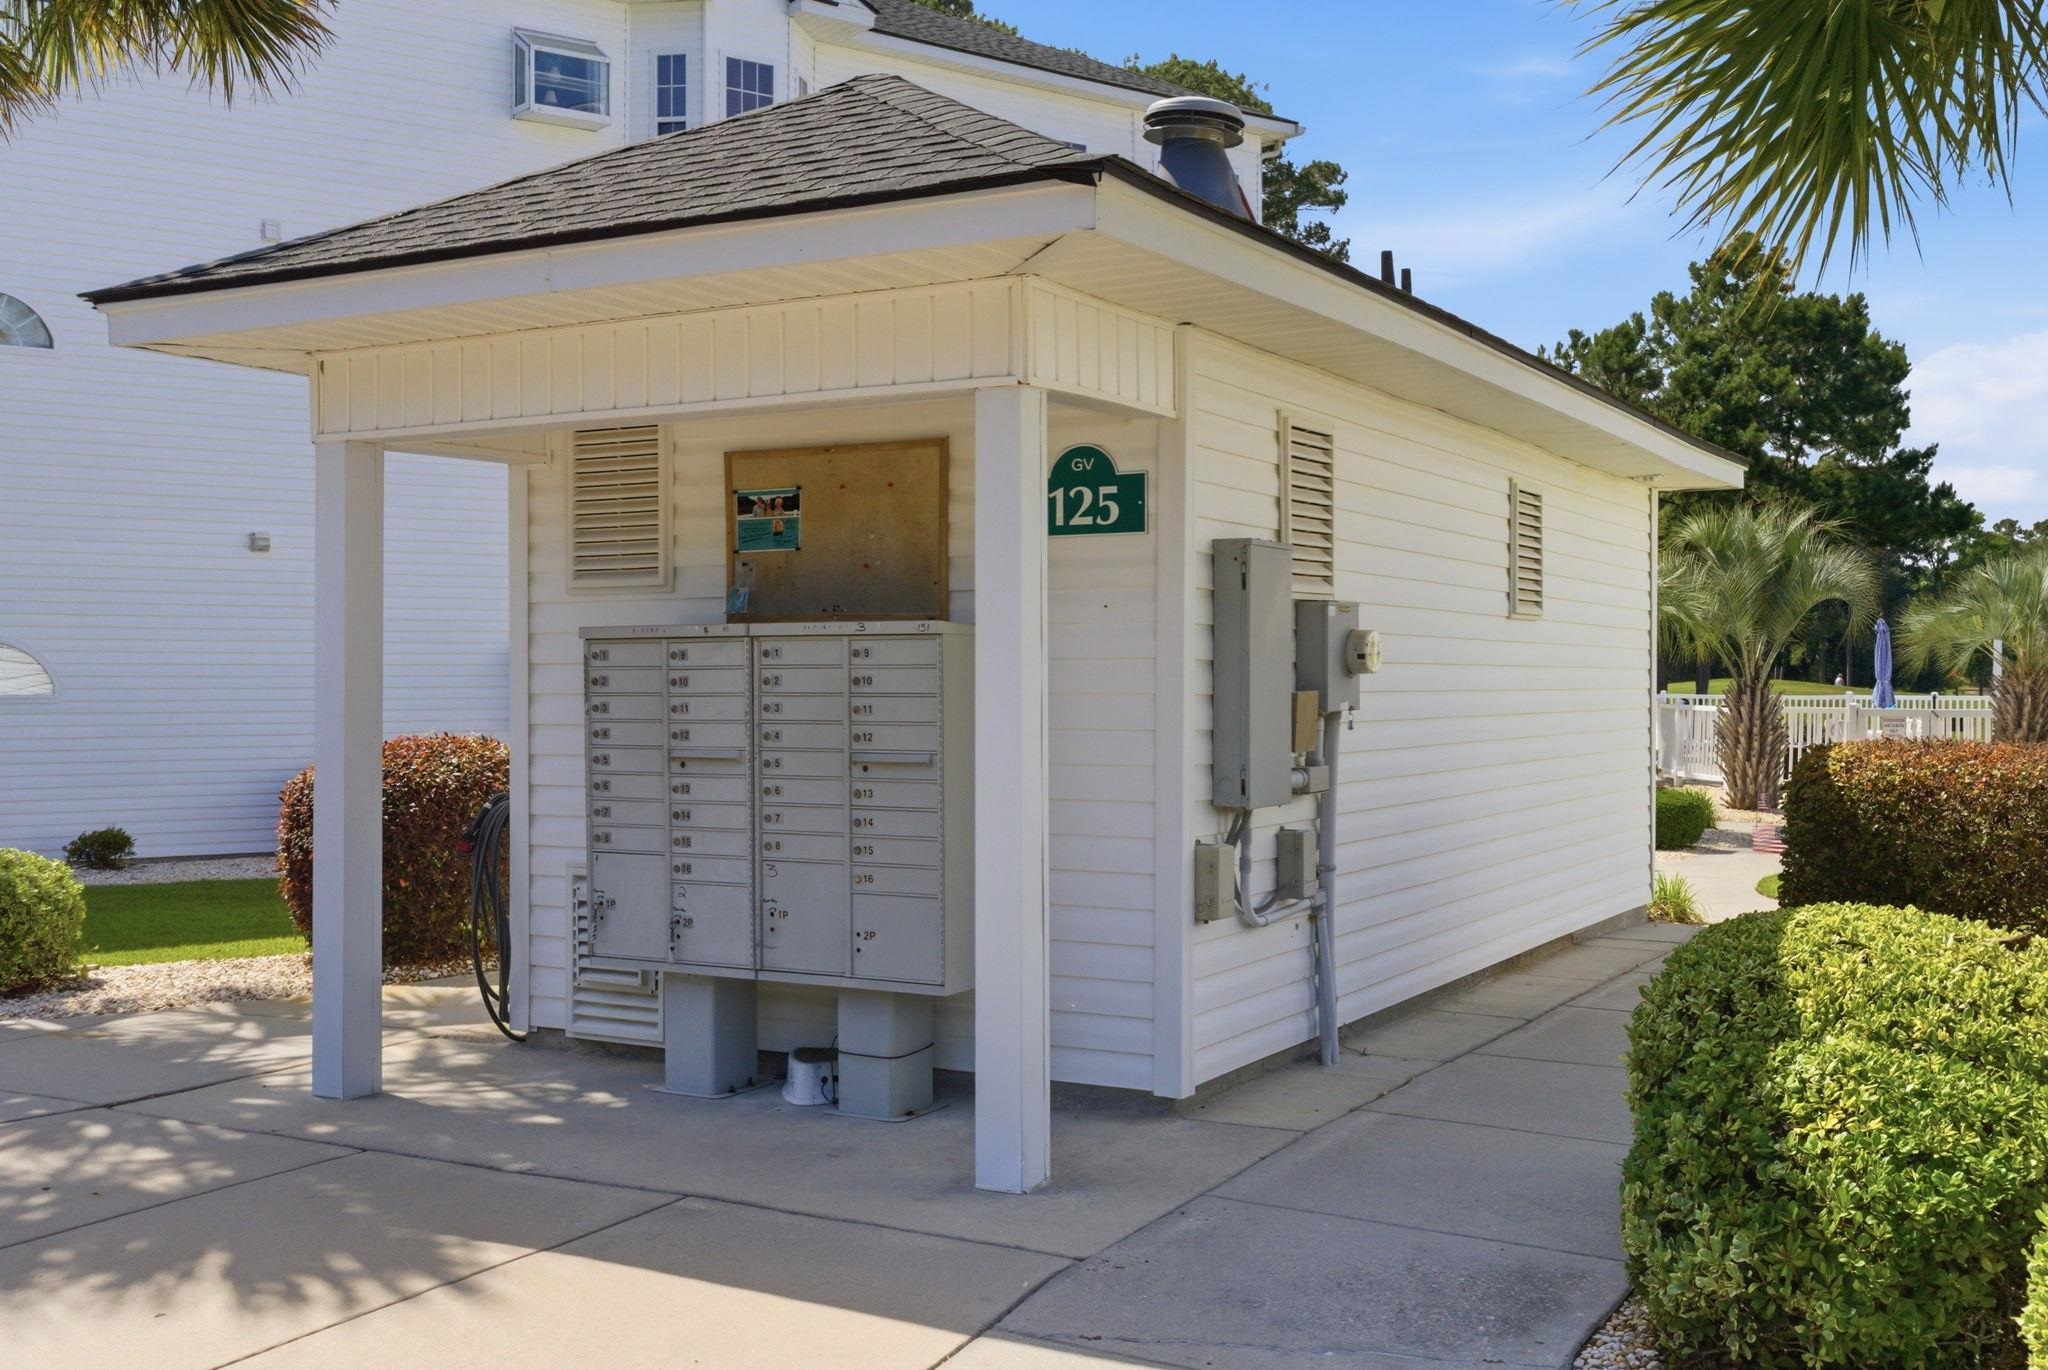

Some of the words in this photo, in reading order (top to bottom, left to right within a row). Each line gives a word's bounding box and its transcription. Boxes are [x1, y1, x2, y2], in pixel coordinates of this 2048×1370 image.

[1071, 458, 1094, 472] GV
[1048, 485, 1120, 526] 125
[864, 649, 870, 657] 9
[679, 678, 688, 686] 10
[862, 677, 872, 685] 10
[680, 705, 688, 713] 11
[680, 731, 690, 740] 12
[862, 733, 872, 742] 12
[681, 785, 690, 793] 13
[863, 790, 873, 798] 13
[681, 812, 690, 820] 14
[863, 818, 873, 827] 14
[682, 838, 691, 846] 15
[864, 846, 873, 855] 15
[682, 864, 691, 873] 16
[766, 864, 778, 878] 3
[863, 874, 873, 883] 16
[678, 886, 687, 898] 2
[606, 900, 616, 908] 1P
[778, 910, 789, 919] 1P
[863, 932, 876, 940] 2P
